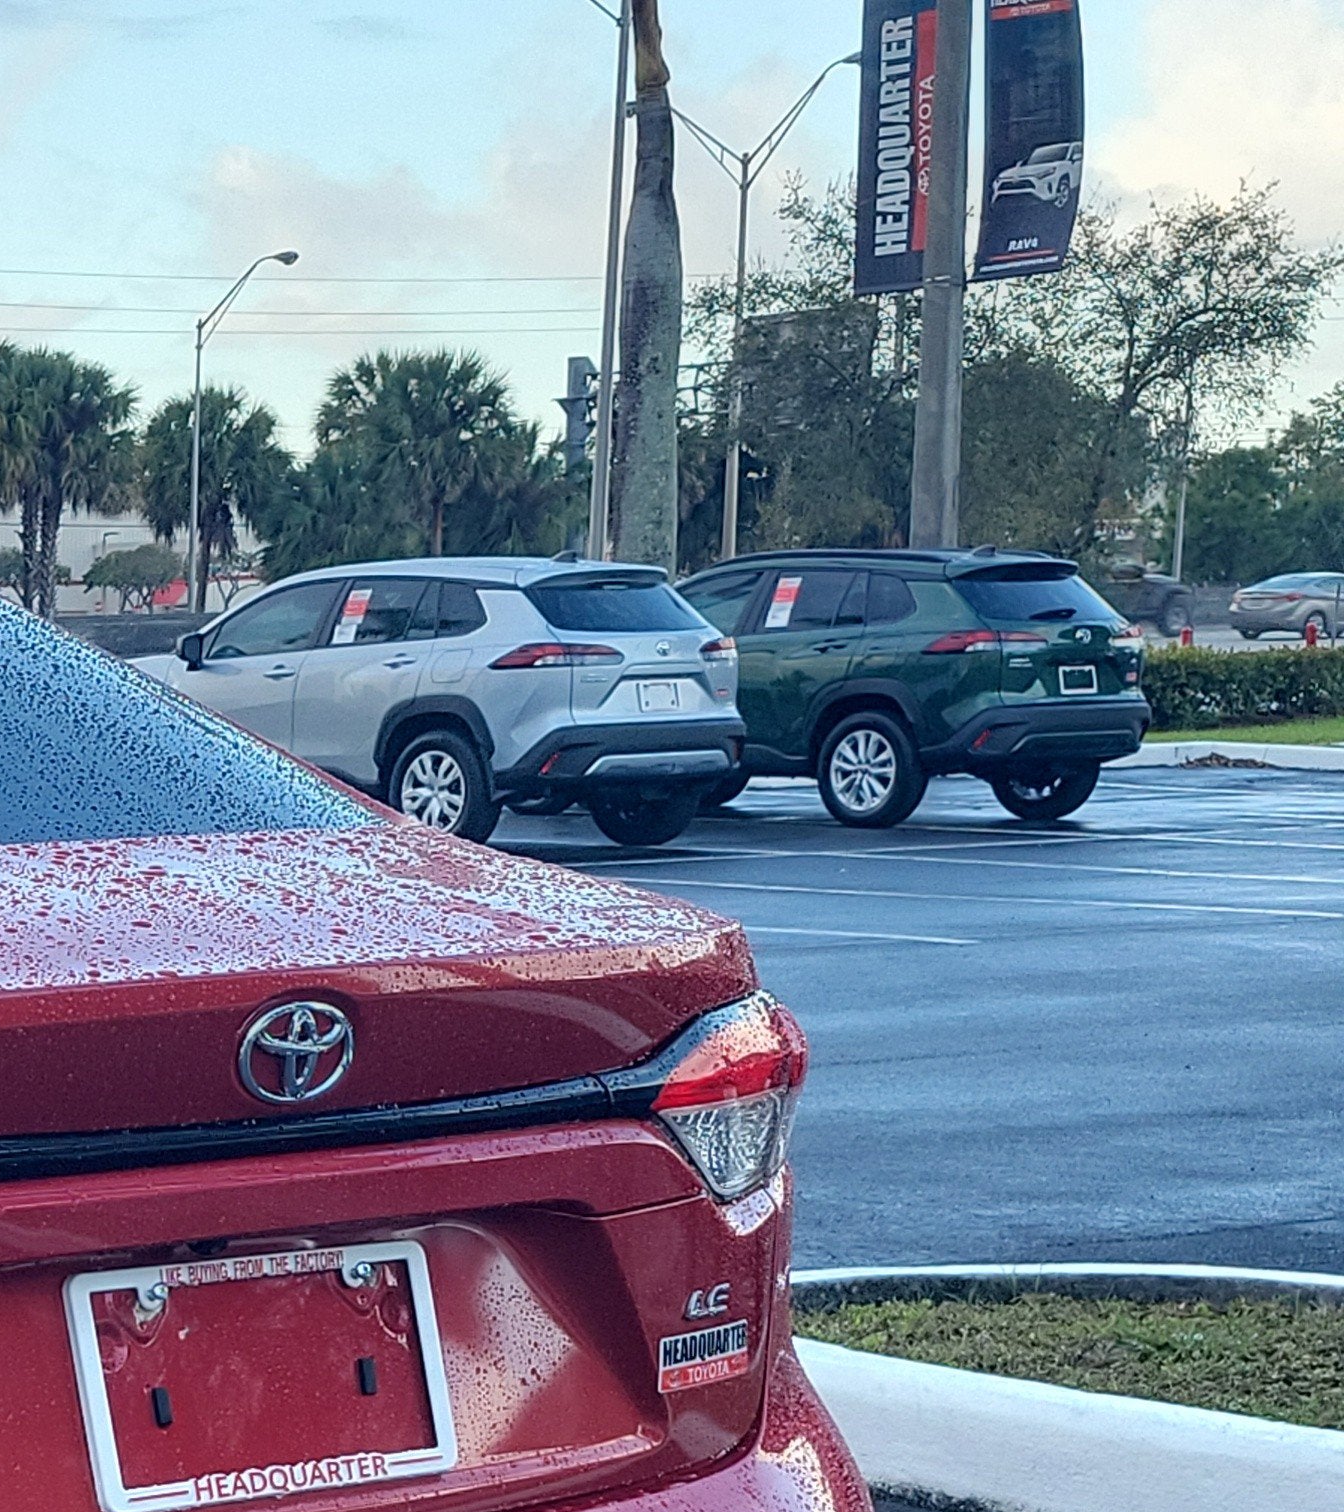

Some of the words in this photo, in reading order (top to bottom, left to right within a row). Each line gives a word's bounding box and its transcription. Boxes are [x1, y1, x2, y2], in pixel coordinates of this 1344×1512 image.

[874, 15, 915, 257] HEADQUARTER
[917, 74, 938, 166] TOYOTA
[1008, 237, 1039, 252] RAV4
[188, 1261, 229, 1284] BUYING
[233, 1257, 264, 1279] FROM
[269, 1254, 290, 1275] THE
[683, 1282, 732, 1320] LE
[687, 1359, 730, 1383] TOYOTA
[193, 1454, 389, 1502] HEADQUARTER
